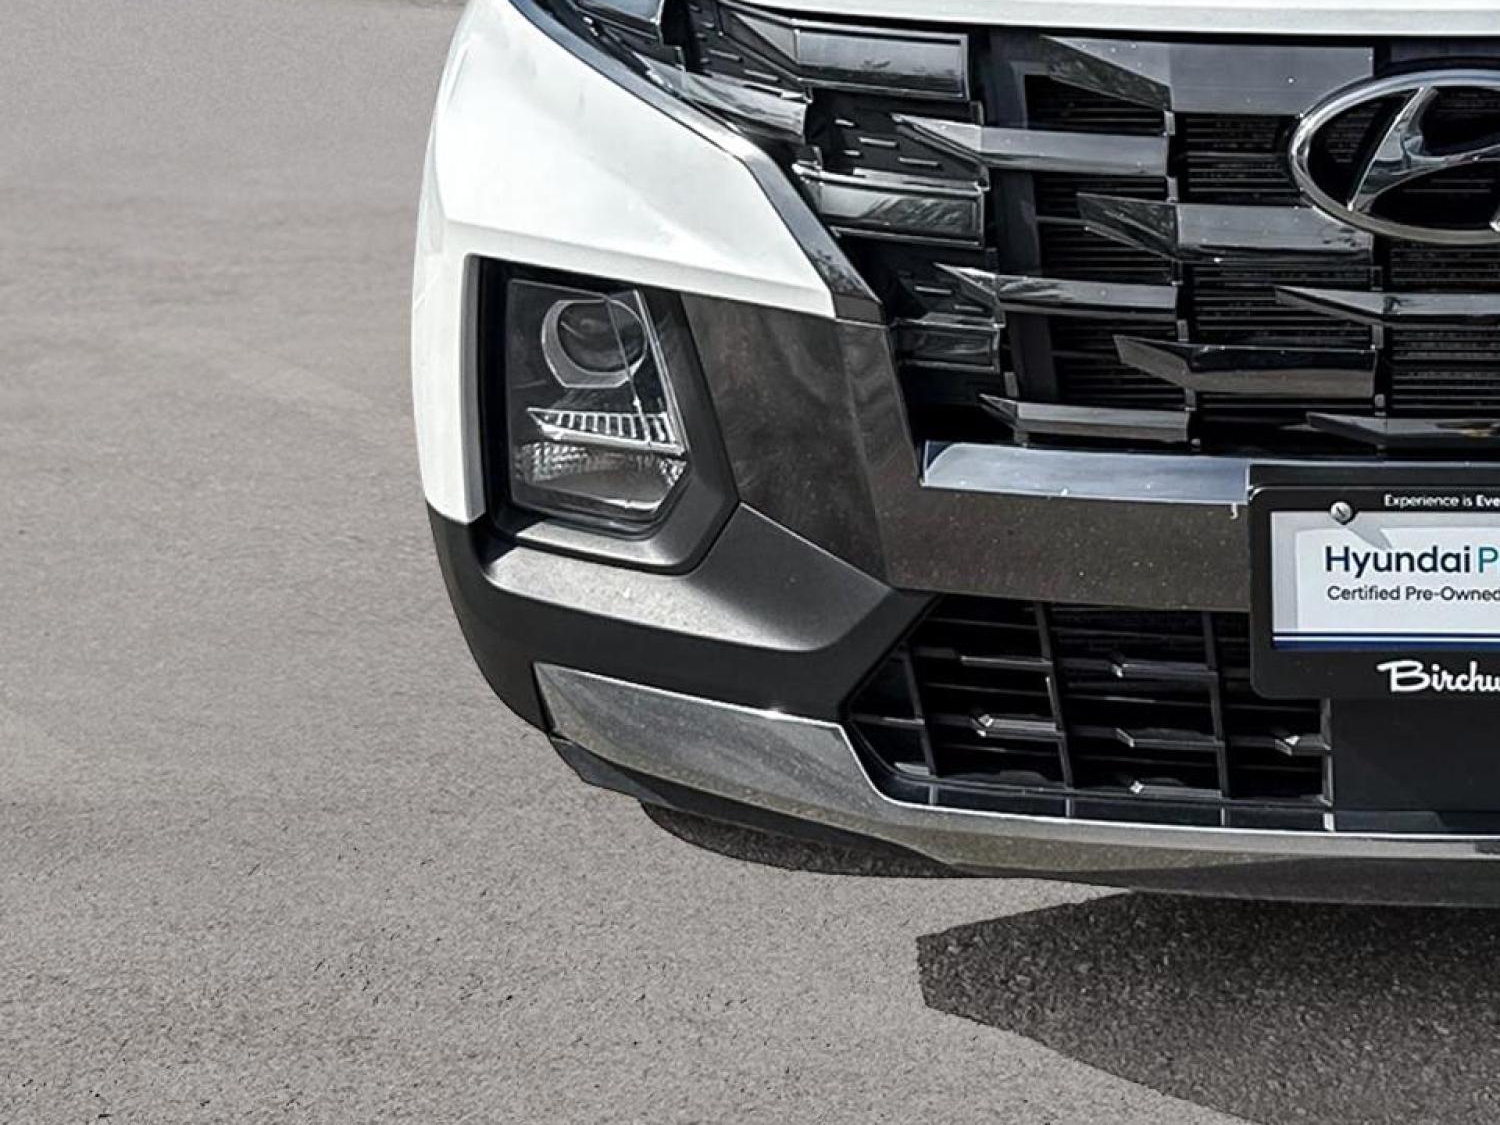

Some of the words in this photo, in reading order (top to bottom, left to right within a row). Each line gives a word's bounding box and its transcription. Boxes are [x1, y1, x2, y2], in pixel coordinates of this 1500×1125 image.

[1384, 494, 1460, 509] Experience
[1462, 494, 1473, 507] is
[1325, 545, 1471, 579] Hyundai
[1327, 585, 1400, 602] Certified
